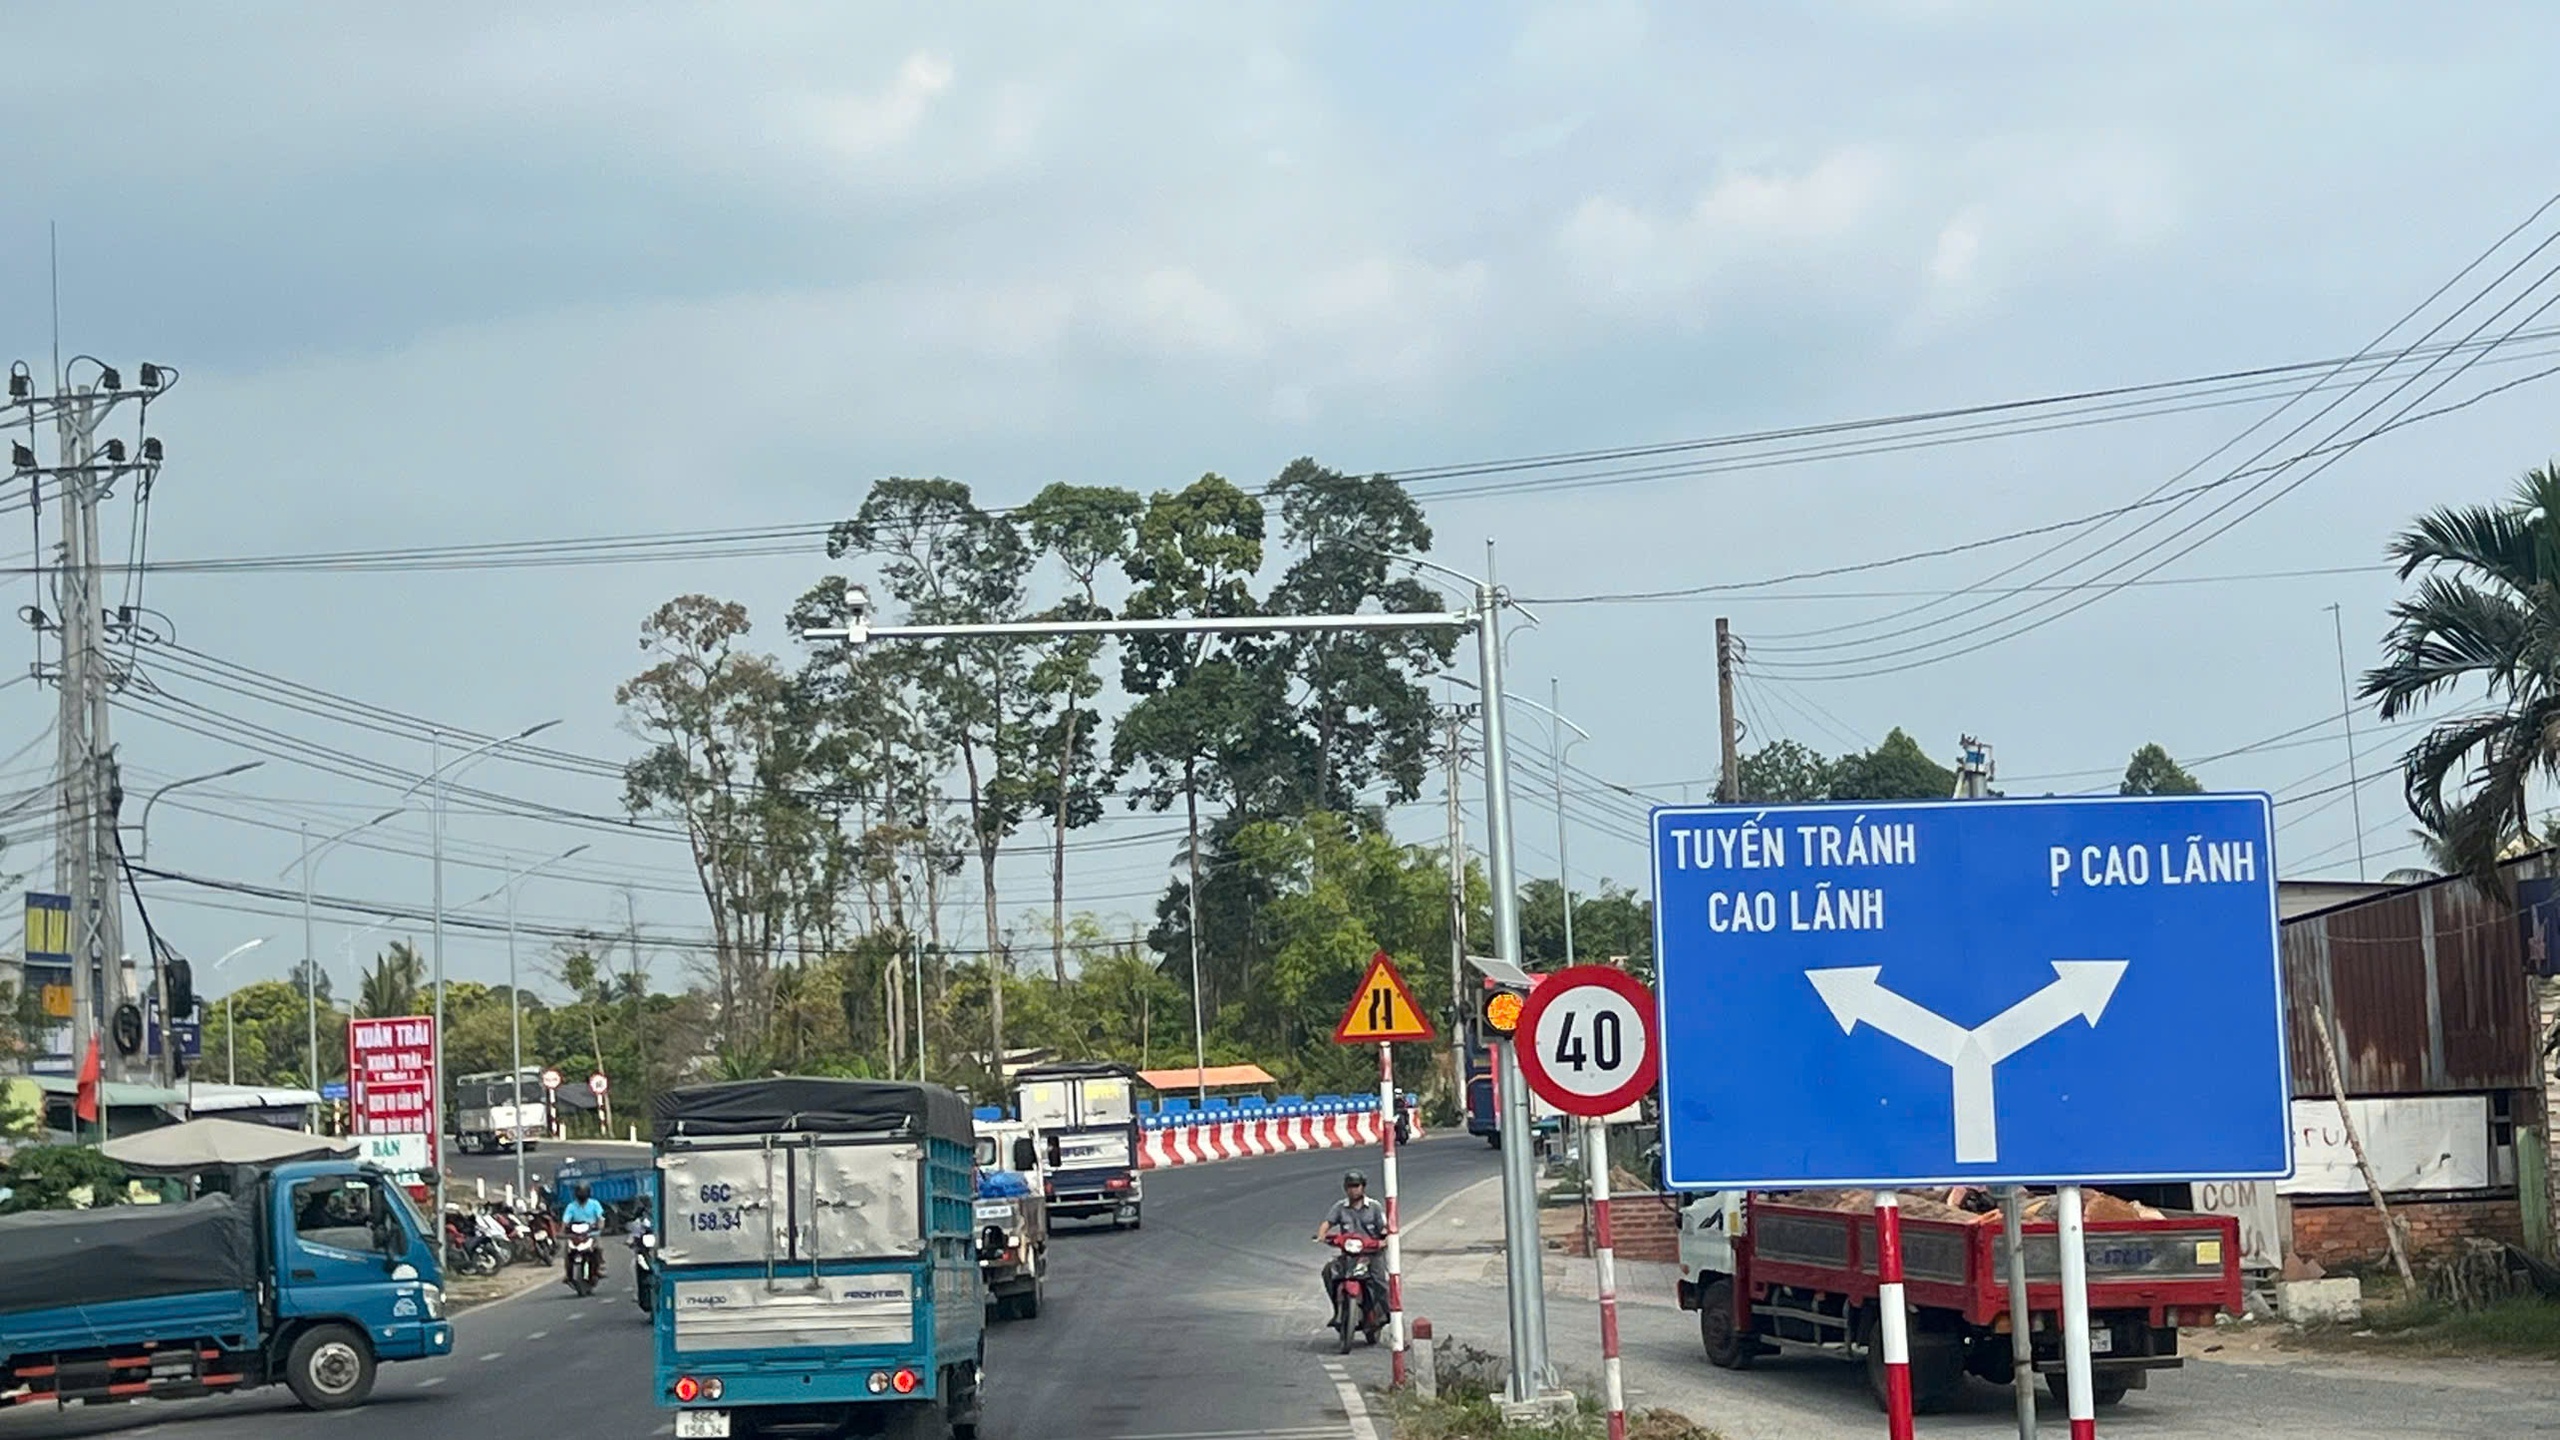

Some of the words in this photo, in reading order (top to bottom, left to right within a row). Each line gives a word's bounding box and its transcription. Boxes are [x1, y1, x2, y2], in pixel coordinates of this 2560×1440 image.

[1670, 812, 1785, 869] TUYẾN
[1797, 815, 1916, 867] TRÁNH
[2081, 844, 2150, 887] CAO
[2160, 834, 2256, 885] LÃNH
[1708, 891, 1777, 933] CAO
[1789, 881, 1884, 931] LÃNH
[1555, 1009, 1622, 1072] 40
[700, 1183, 731, 1204] 66C
